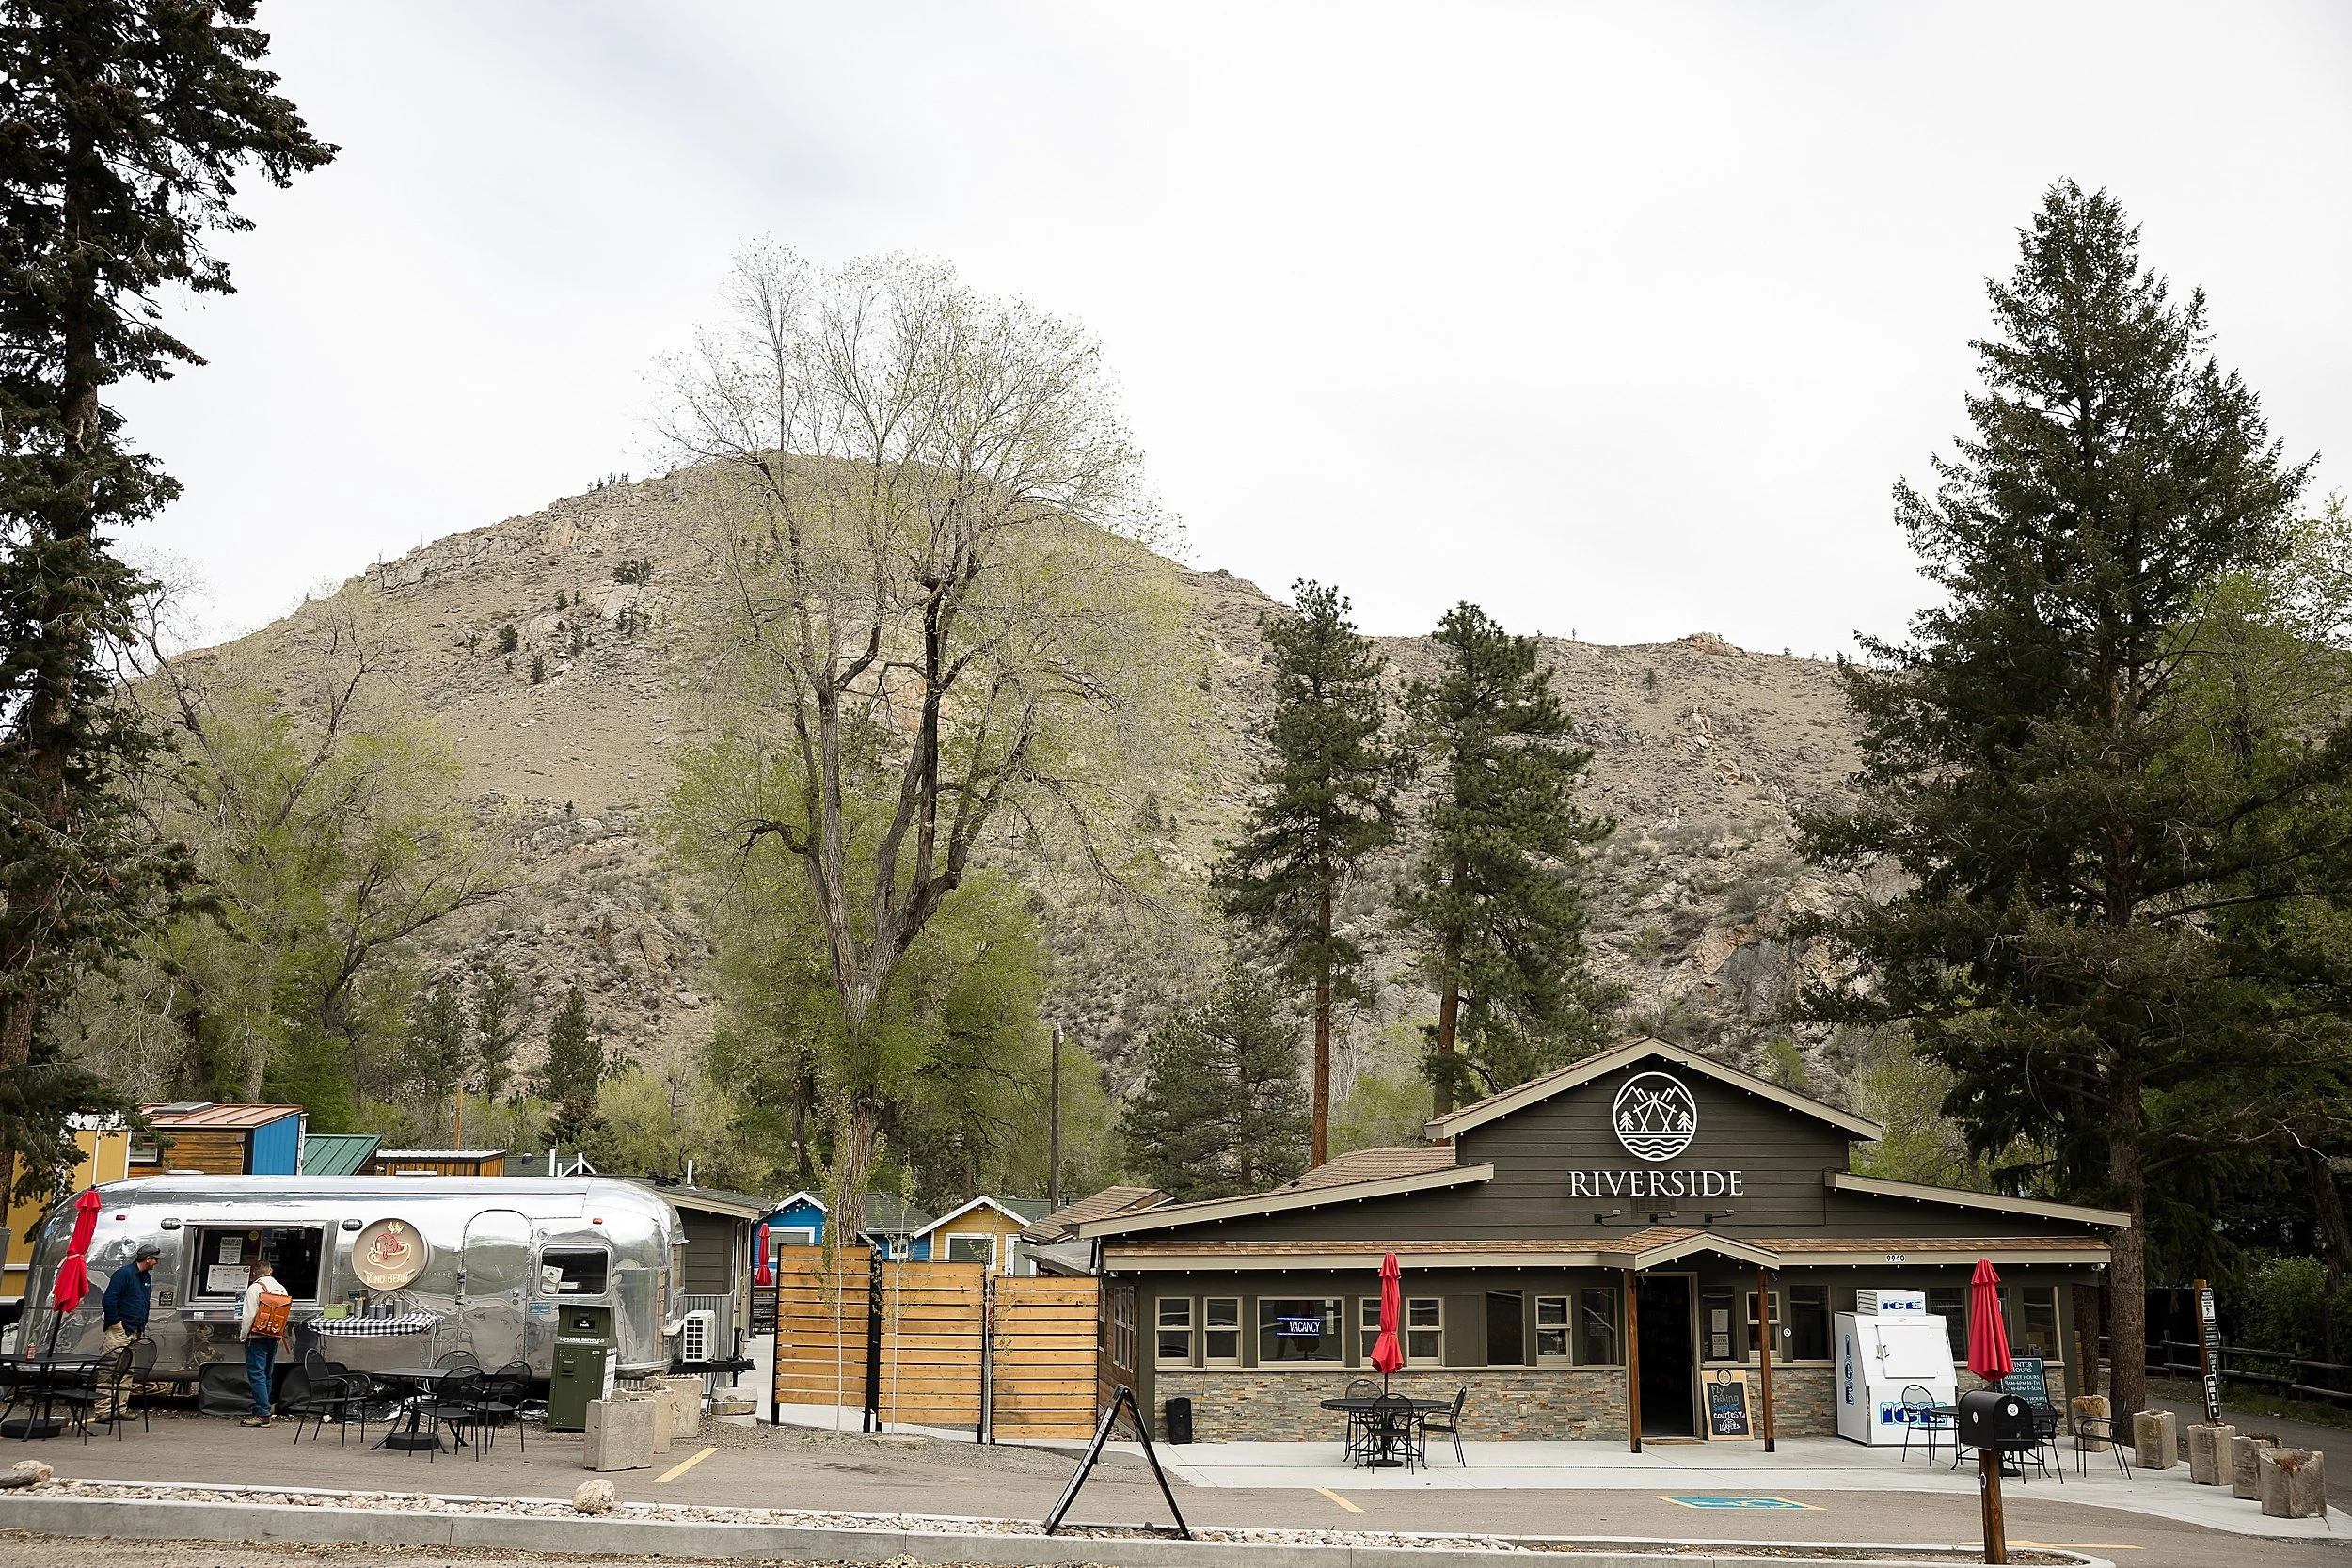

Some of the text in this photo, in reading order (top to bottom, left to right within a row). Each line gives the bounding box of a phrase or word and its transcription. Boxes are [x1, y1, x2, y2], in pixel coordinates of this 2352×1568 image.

[1568, 1170, 1745, 1196] RIVERSIDE
[388, 1273, 407, 1283] BEAN
[1882, 1300, 1924, 1310] ICE
[1290, 1321, 1320, 1332] VACANCY
[1844, 1335, 1854, 1405] ICE
[1713, 1411, 1742, 1419] courtesy
[1881, 1402, 1947, 1425] ICE
